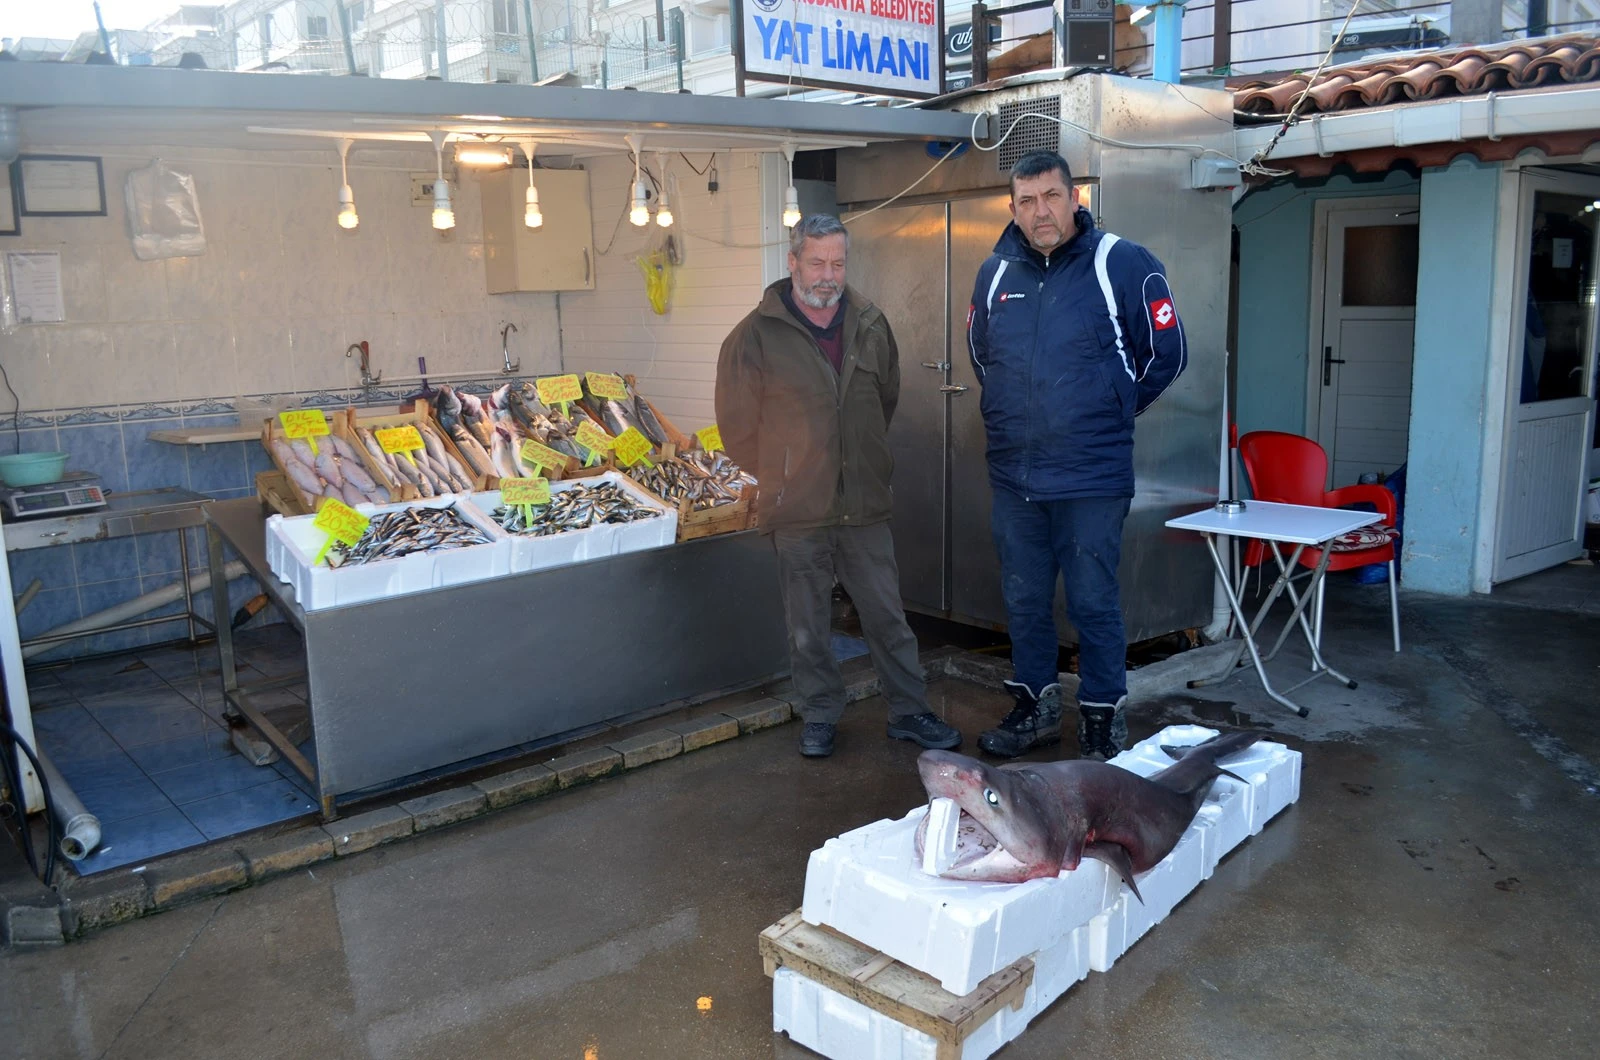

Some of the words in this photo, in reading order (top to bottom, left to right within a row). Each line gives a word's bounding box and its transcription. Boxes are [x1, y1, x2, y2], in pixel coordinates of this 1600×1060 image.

[753, 15, 813, 65] YAT
[820, 19, 930, 81] LİMANI
[505, 489, 522, 502] 20
[316, 508, 342, 531] 20
